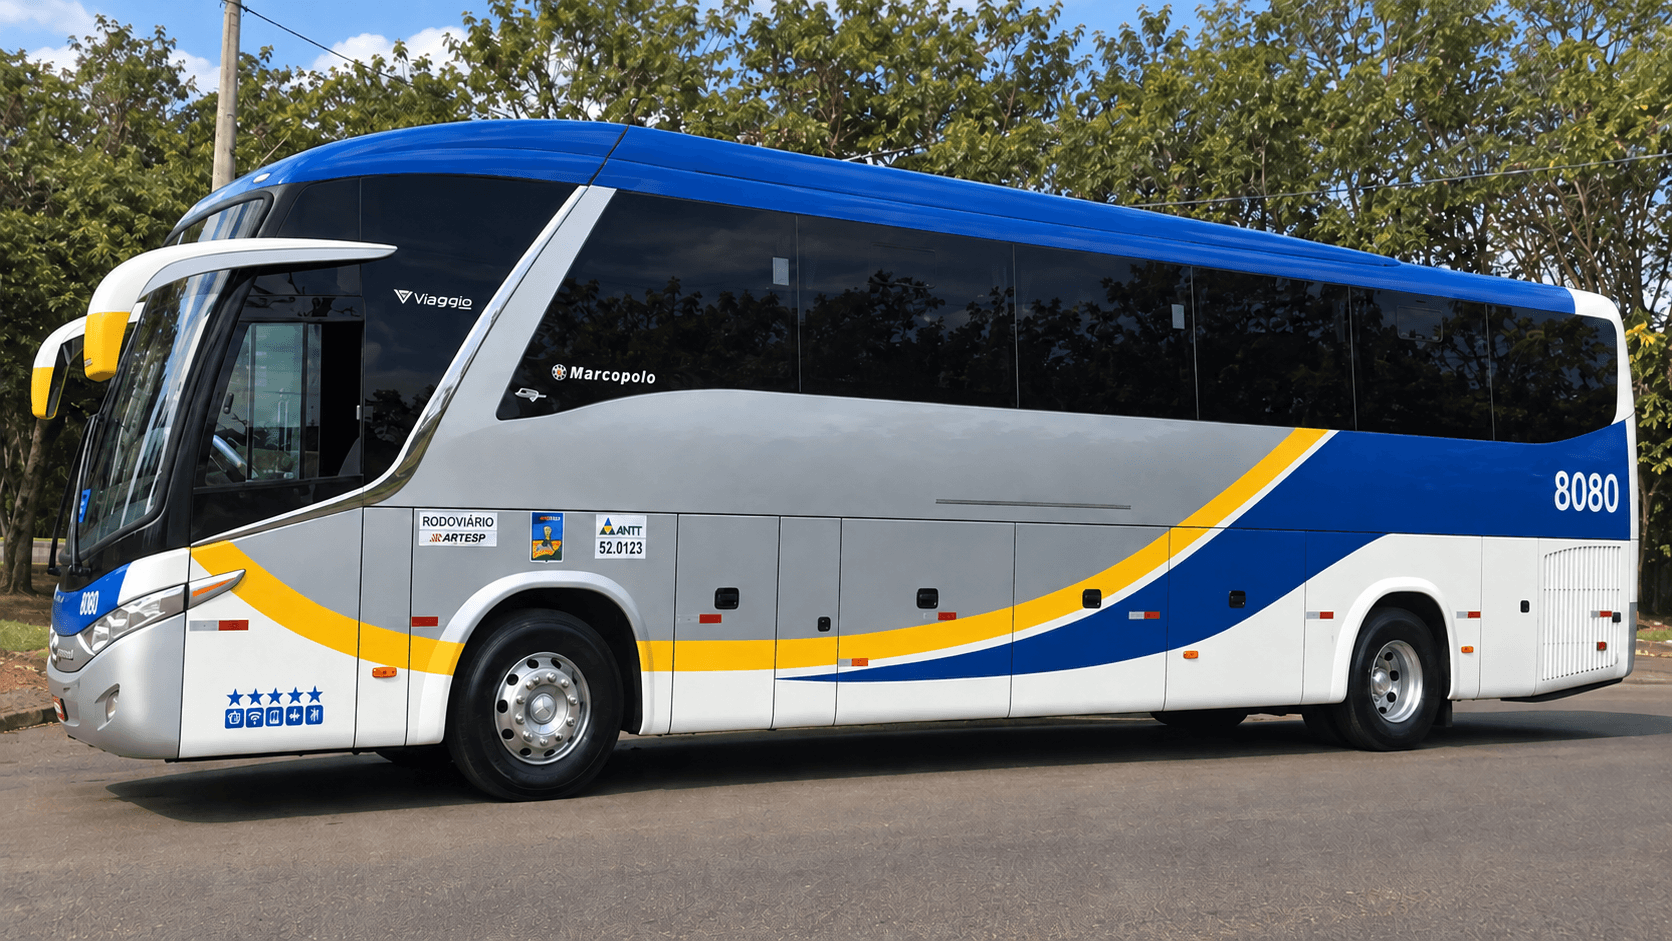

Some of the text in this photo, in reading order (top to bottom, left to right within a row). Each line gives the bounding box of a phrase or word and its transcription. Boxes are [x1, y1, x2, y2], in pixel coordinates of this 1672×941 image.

[414, 292, 473, 310] Viaggio
[569, 366, 656, 385] Marcopolo
[1554, 470, 1619, 513] 8080
[422, 514, 494, 528] RODOVIÁRIO
[616, 525, 643, 536] ANTT
[442, 533, 486, 543] ARTESP
[599, 541, 643, 555] 52.0123
